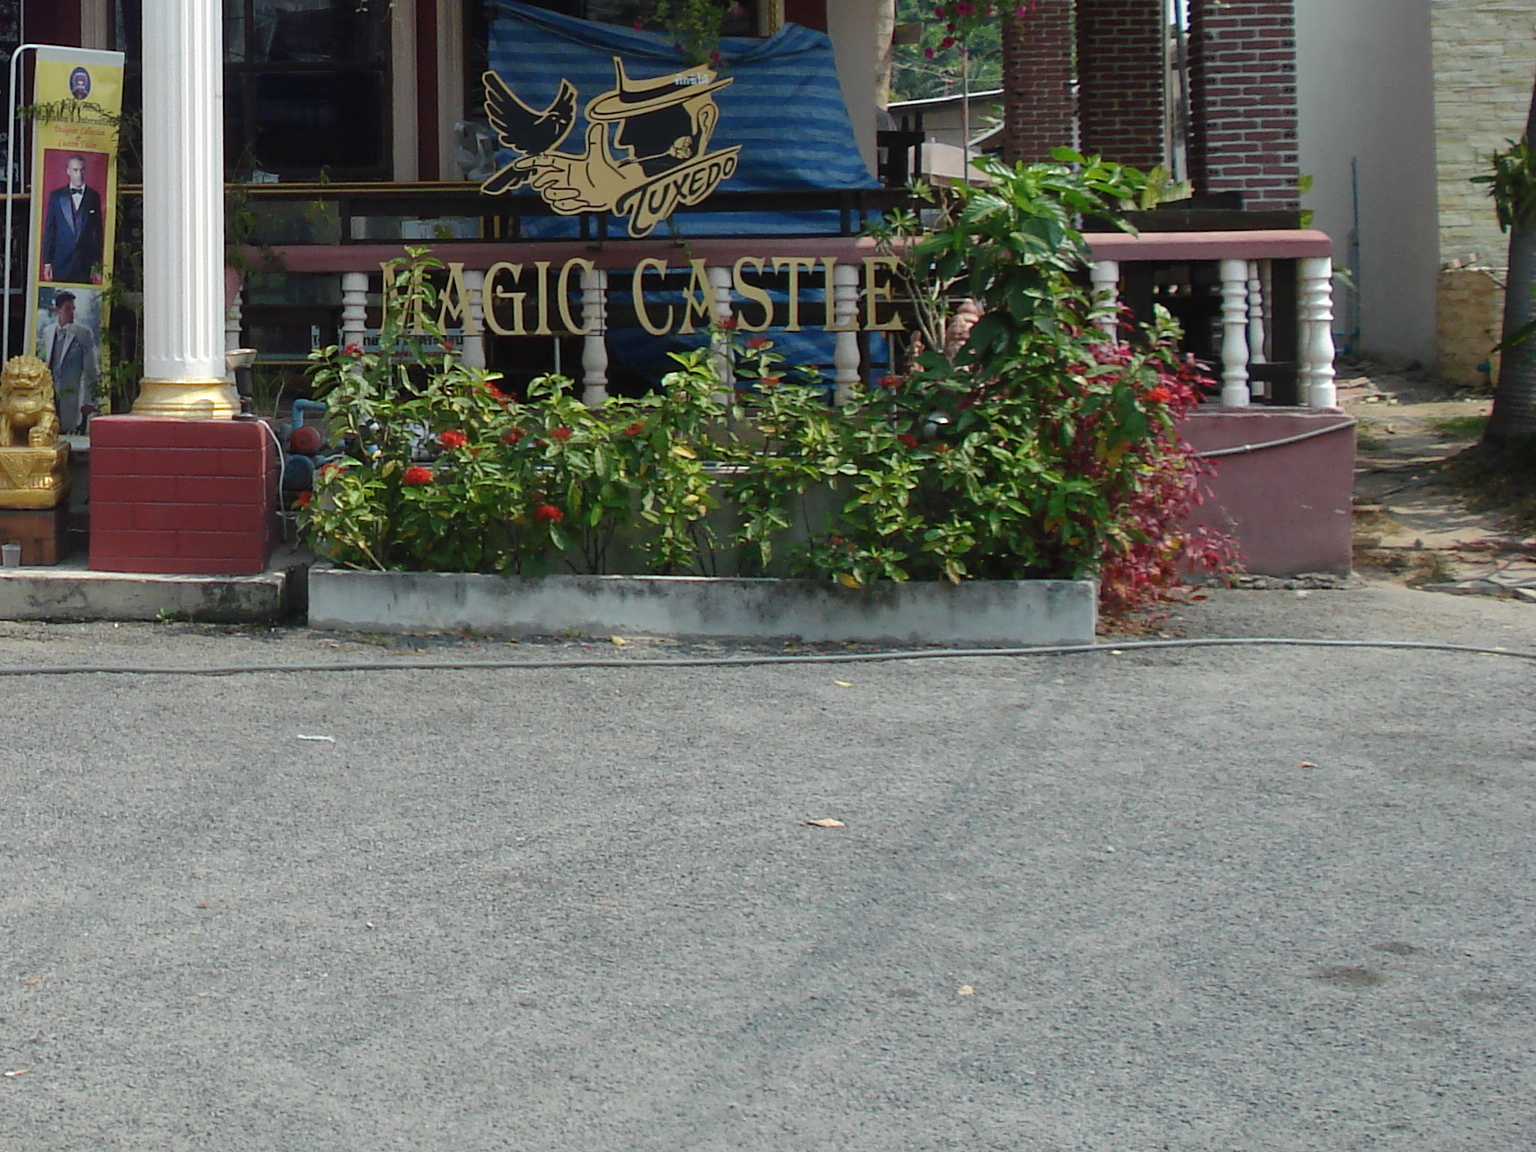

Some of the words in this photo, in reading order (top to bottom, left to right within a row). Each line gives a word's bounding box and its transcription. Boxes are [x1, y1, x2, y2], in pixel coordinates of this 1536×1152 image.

[616, 146, 742, 237] TUXEDO
[380, 258, 597, 337] MAGIC
[632, 255, 905, 337] CASTLE
